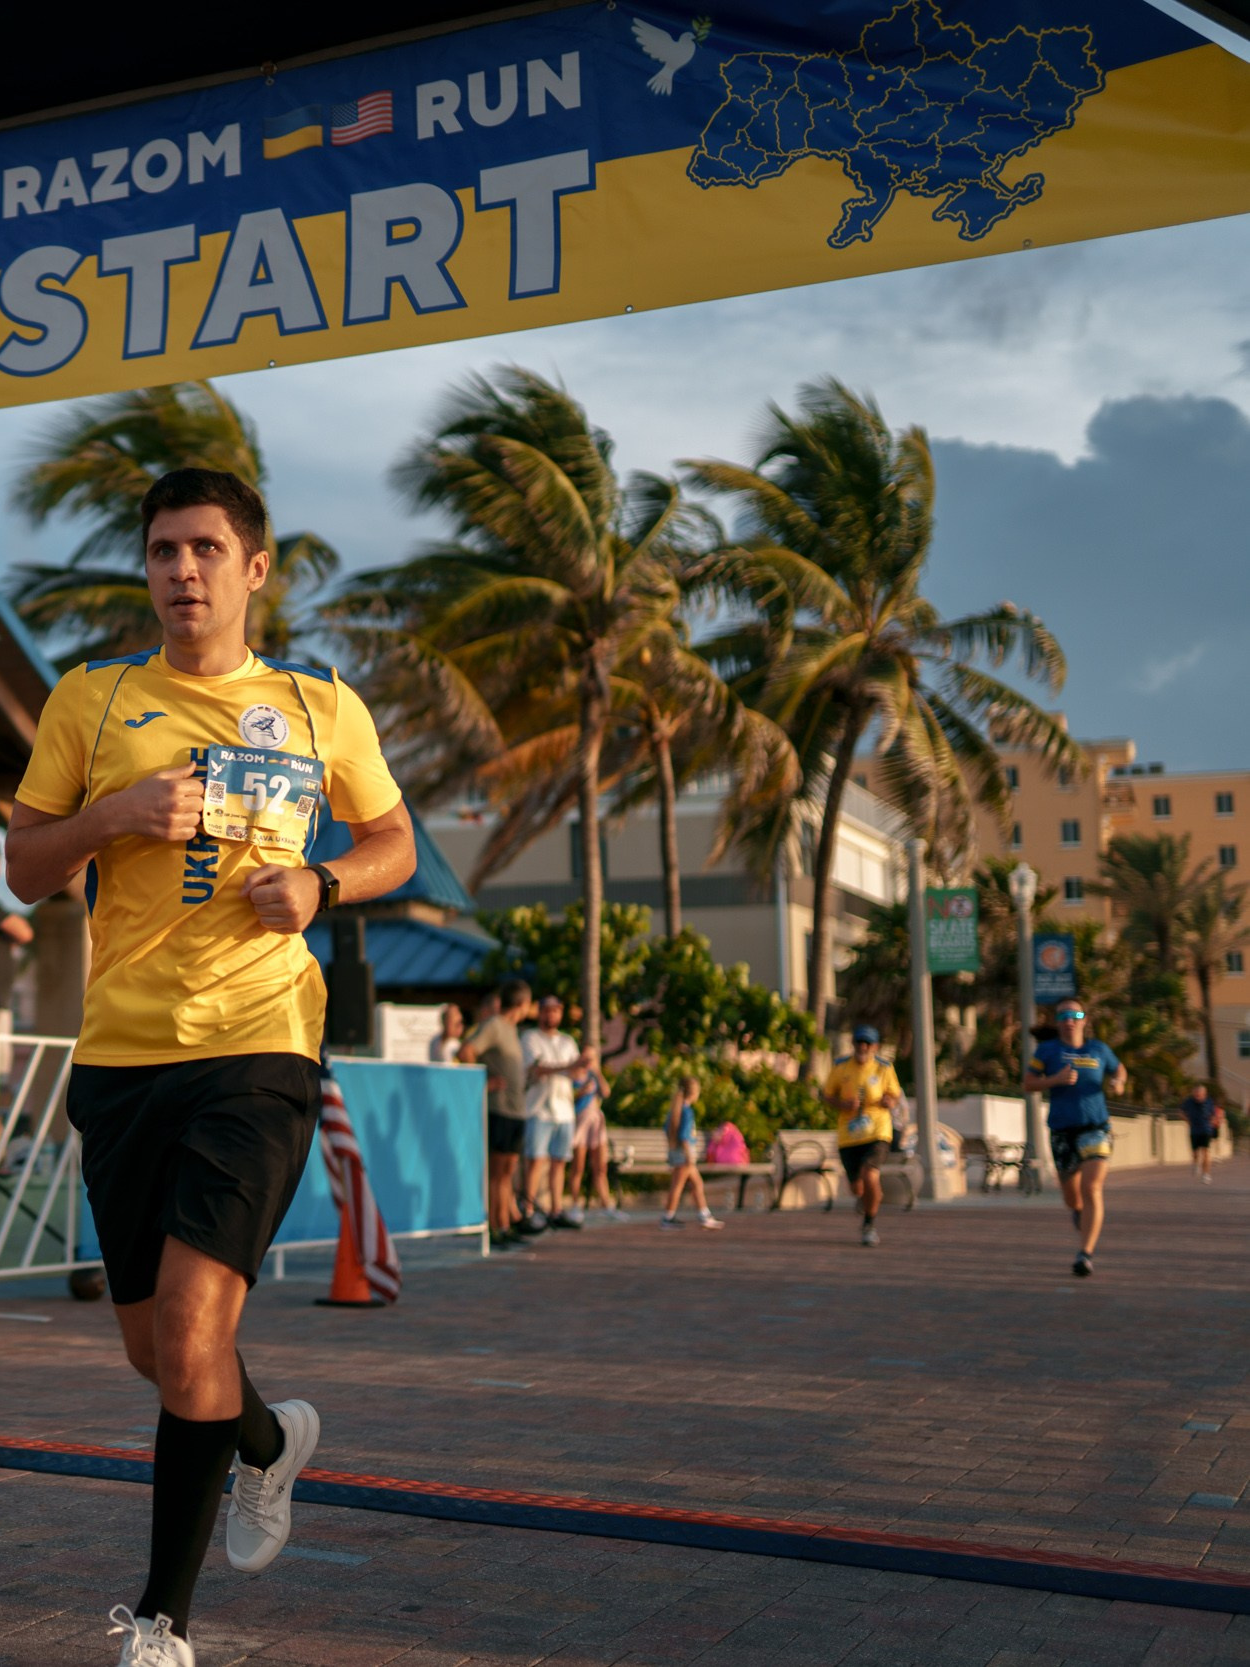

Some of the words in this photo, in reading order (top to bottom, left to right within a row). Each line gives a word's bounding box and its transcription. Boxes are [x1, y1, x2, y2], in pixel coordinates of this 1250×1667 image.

[2, 122, 241, 219] RAZOM
[416, 51, 582, 139] RUN
[220, 750, 265, 764] RAZOM
[291, 759, 314, 774] RUN
[242, 771, 291, 814] 52
